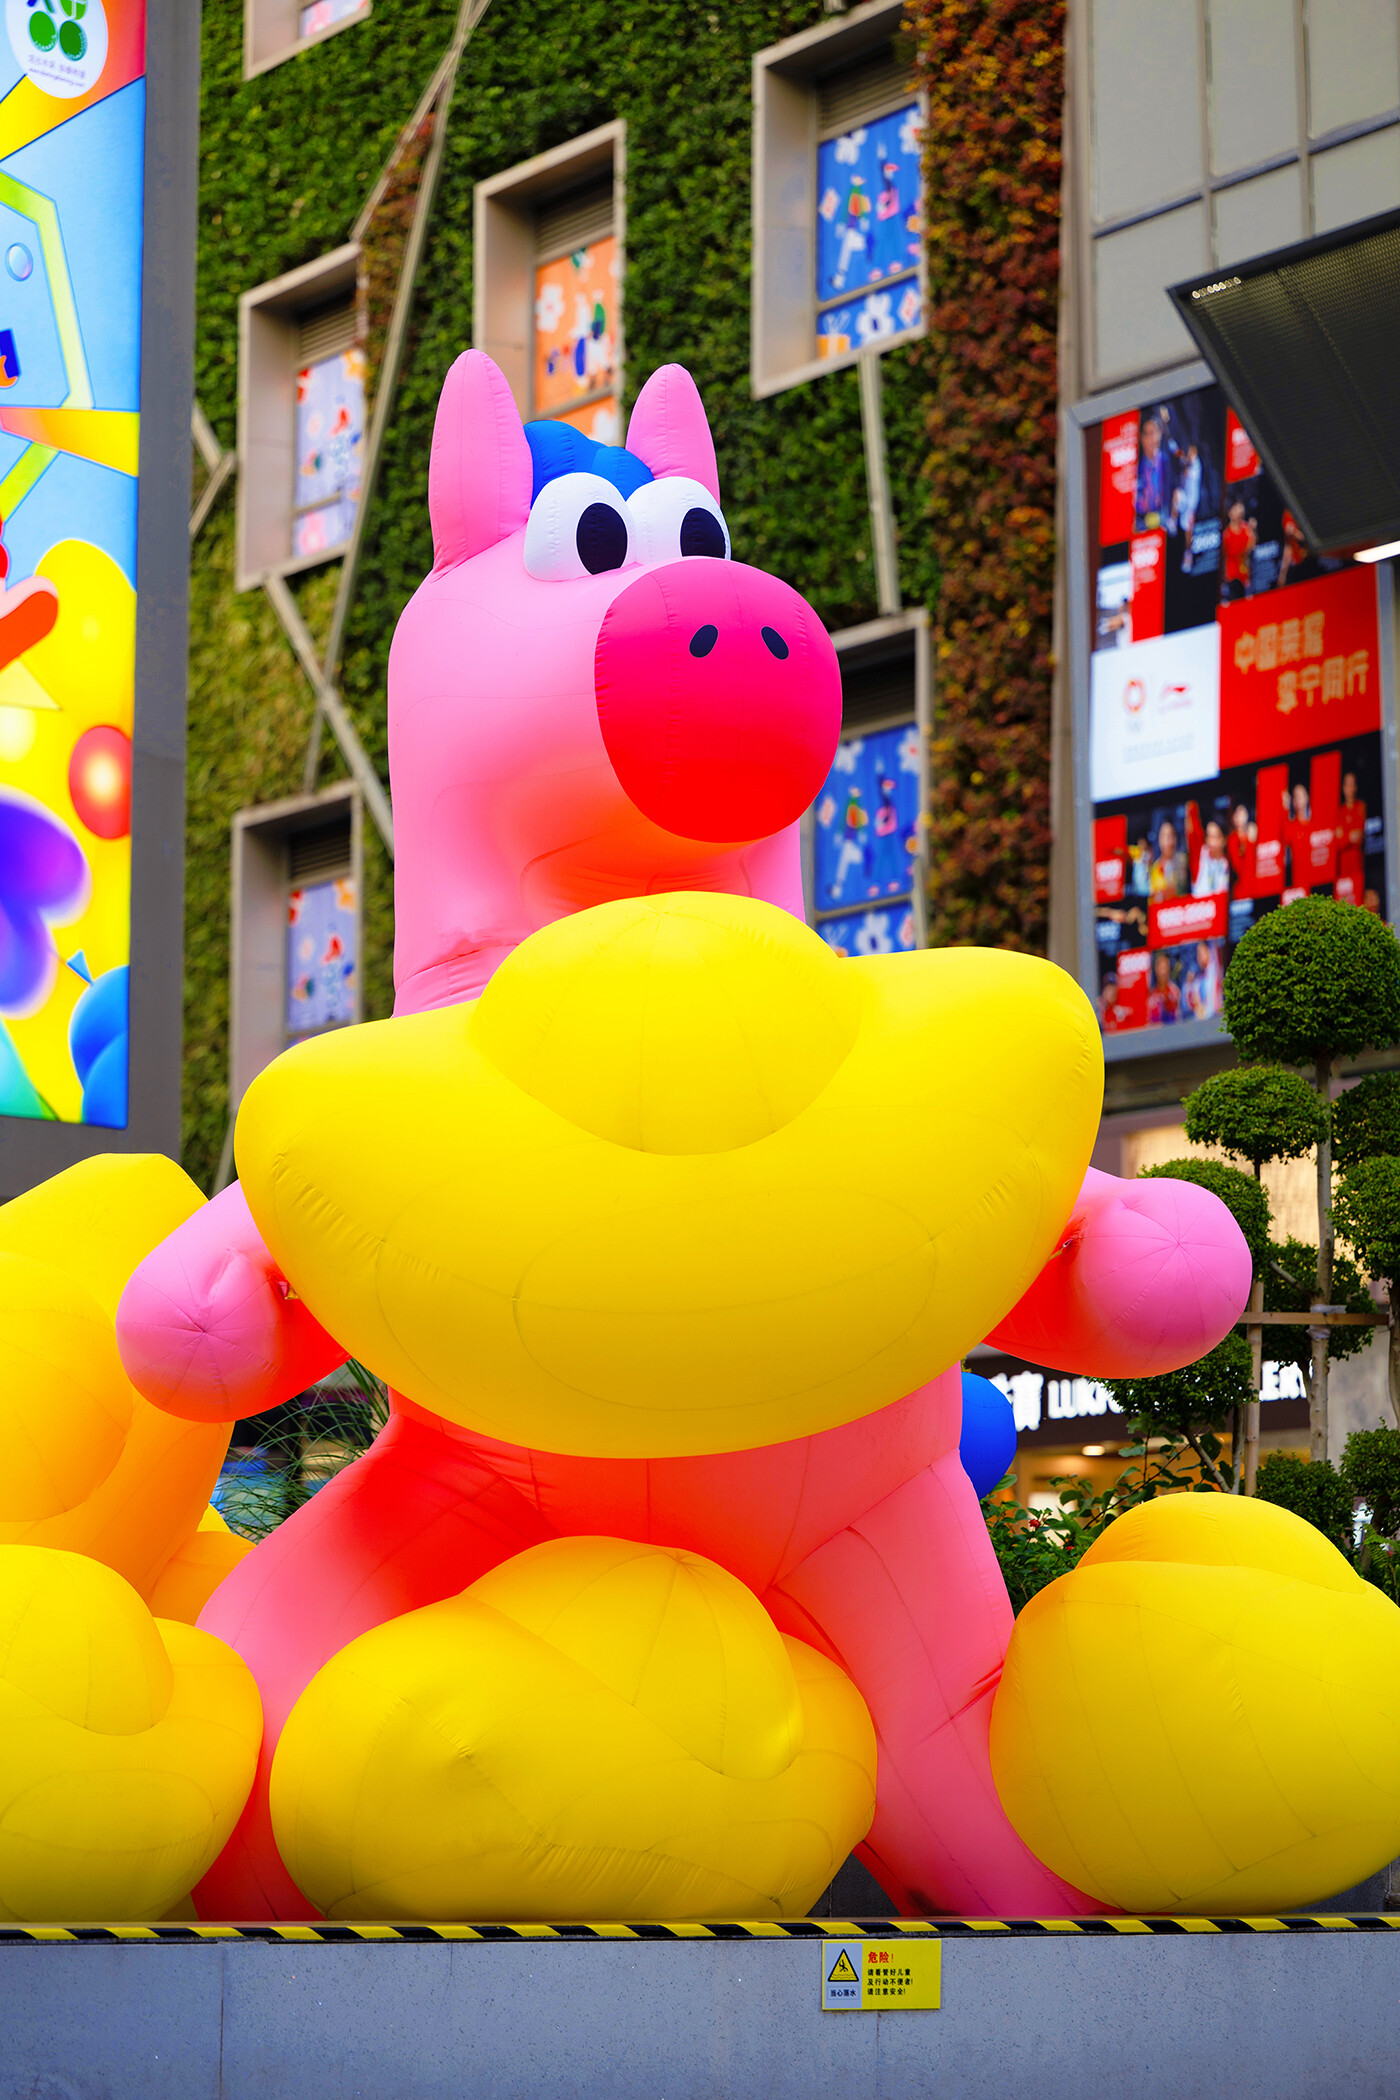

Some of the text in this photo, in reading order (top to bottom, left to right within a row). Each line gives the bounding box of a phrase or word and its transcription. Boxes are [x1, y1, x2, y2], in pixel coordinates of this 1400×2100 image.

[867, 1968, 911, 1976] 请看管好儿童
[830, 1989, 857, 1997] 当心落水
